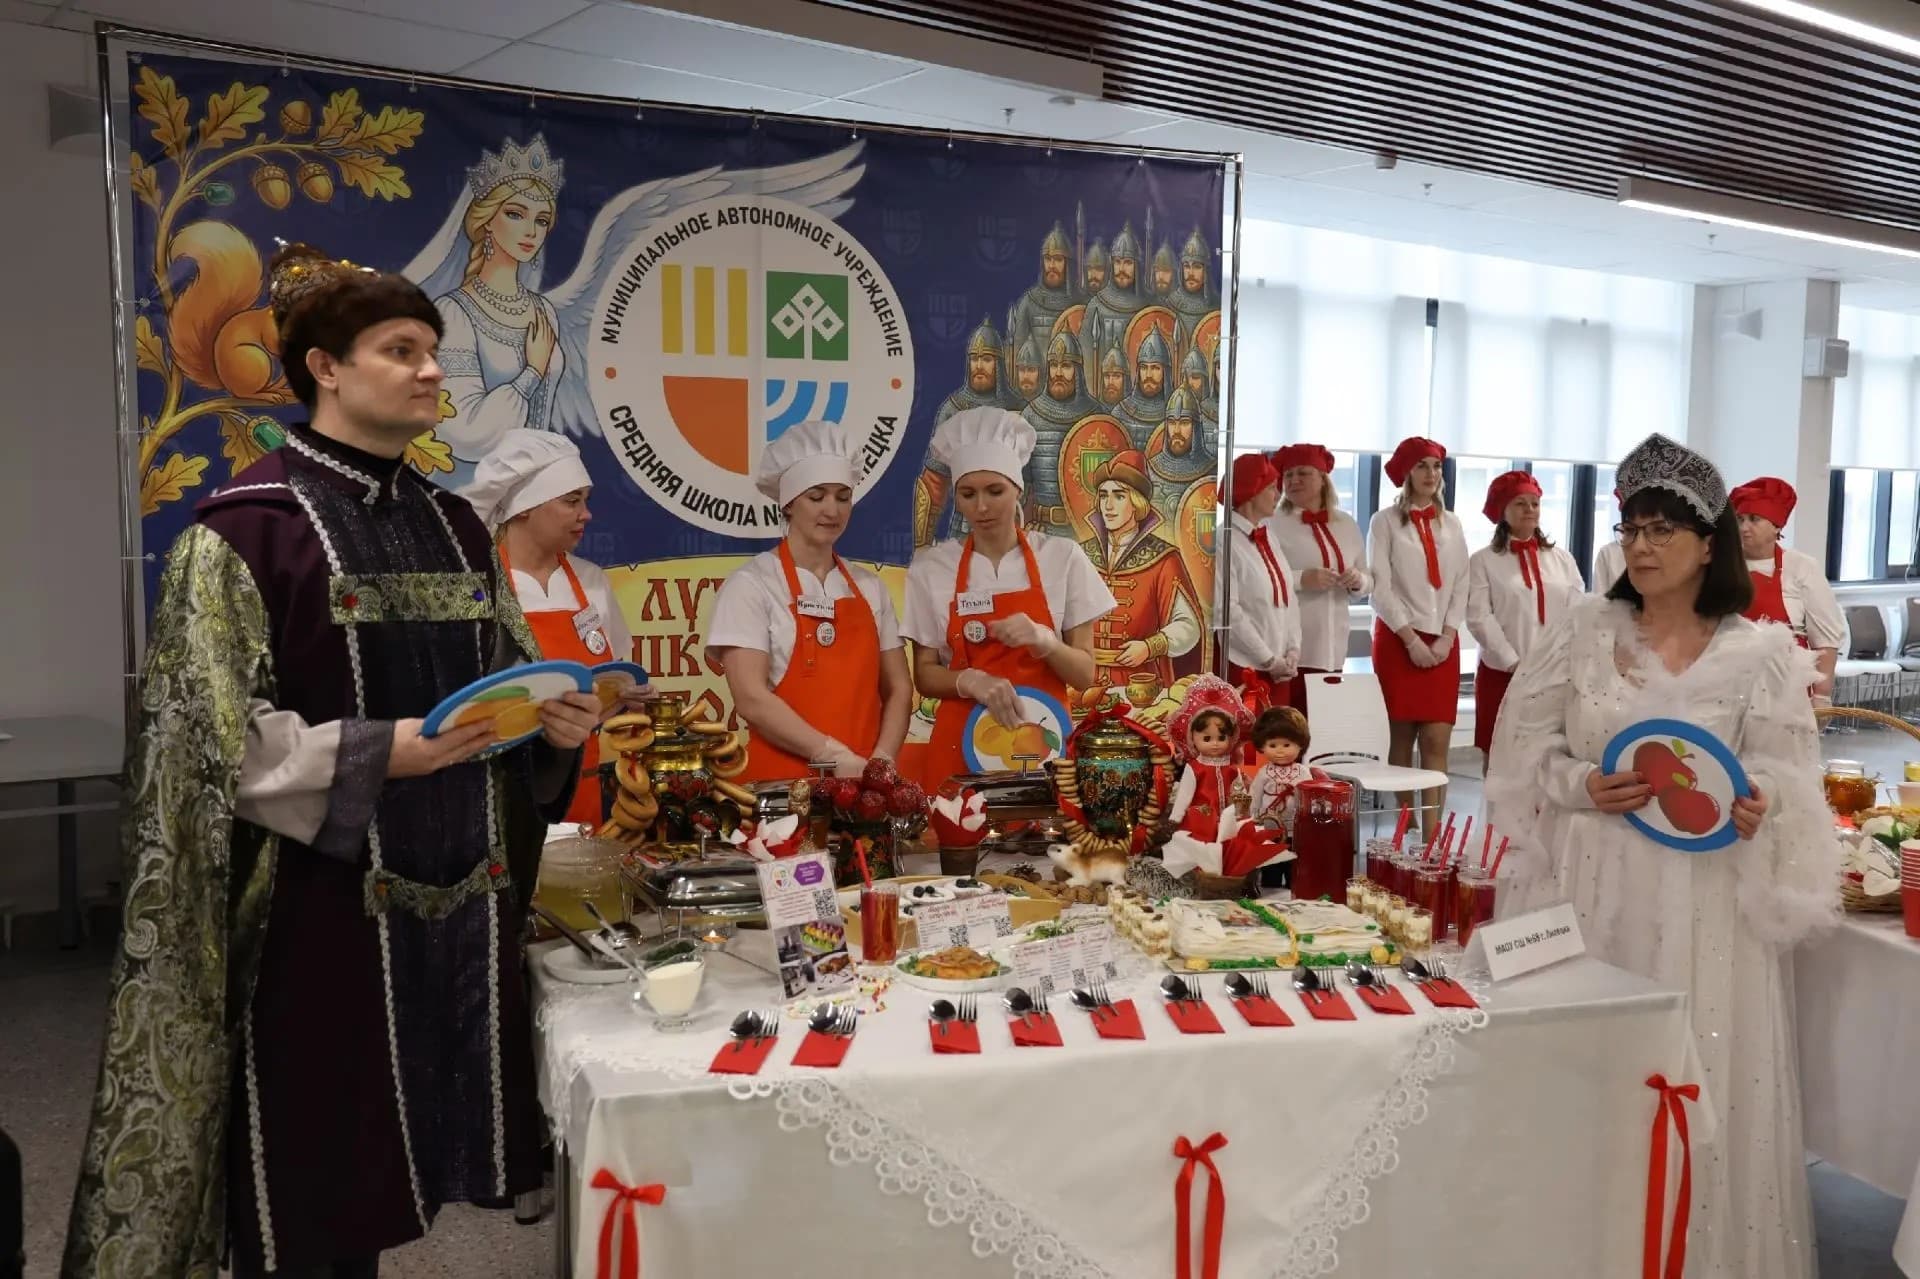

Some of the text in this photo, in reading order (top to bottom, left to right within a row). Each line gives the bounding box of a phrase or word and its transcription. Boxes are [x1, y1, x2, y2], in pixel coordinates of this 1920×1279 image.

[601, 206, 903, 358] МУНИЦИПАЛЬНОЕ АВТОНОМНОЕ УЧРЕЖДЕНИЕ
[609, 404, 684, 498] СРЕДНЯЯ
[681, 485, 758, 526] ШКОЛА
